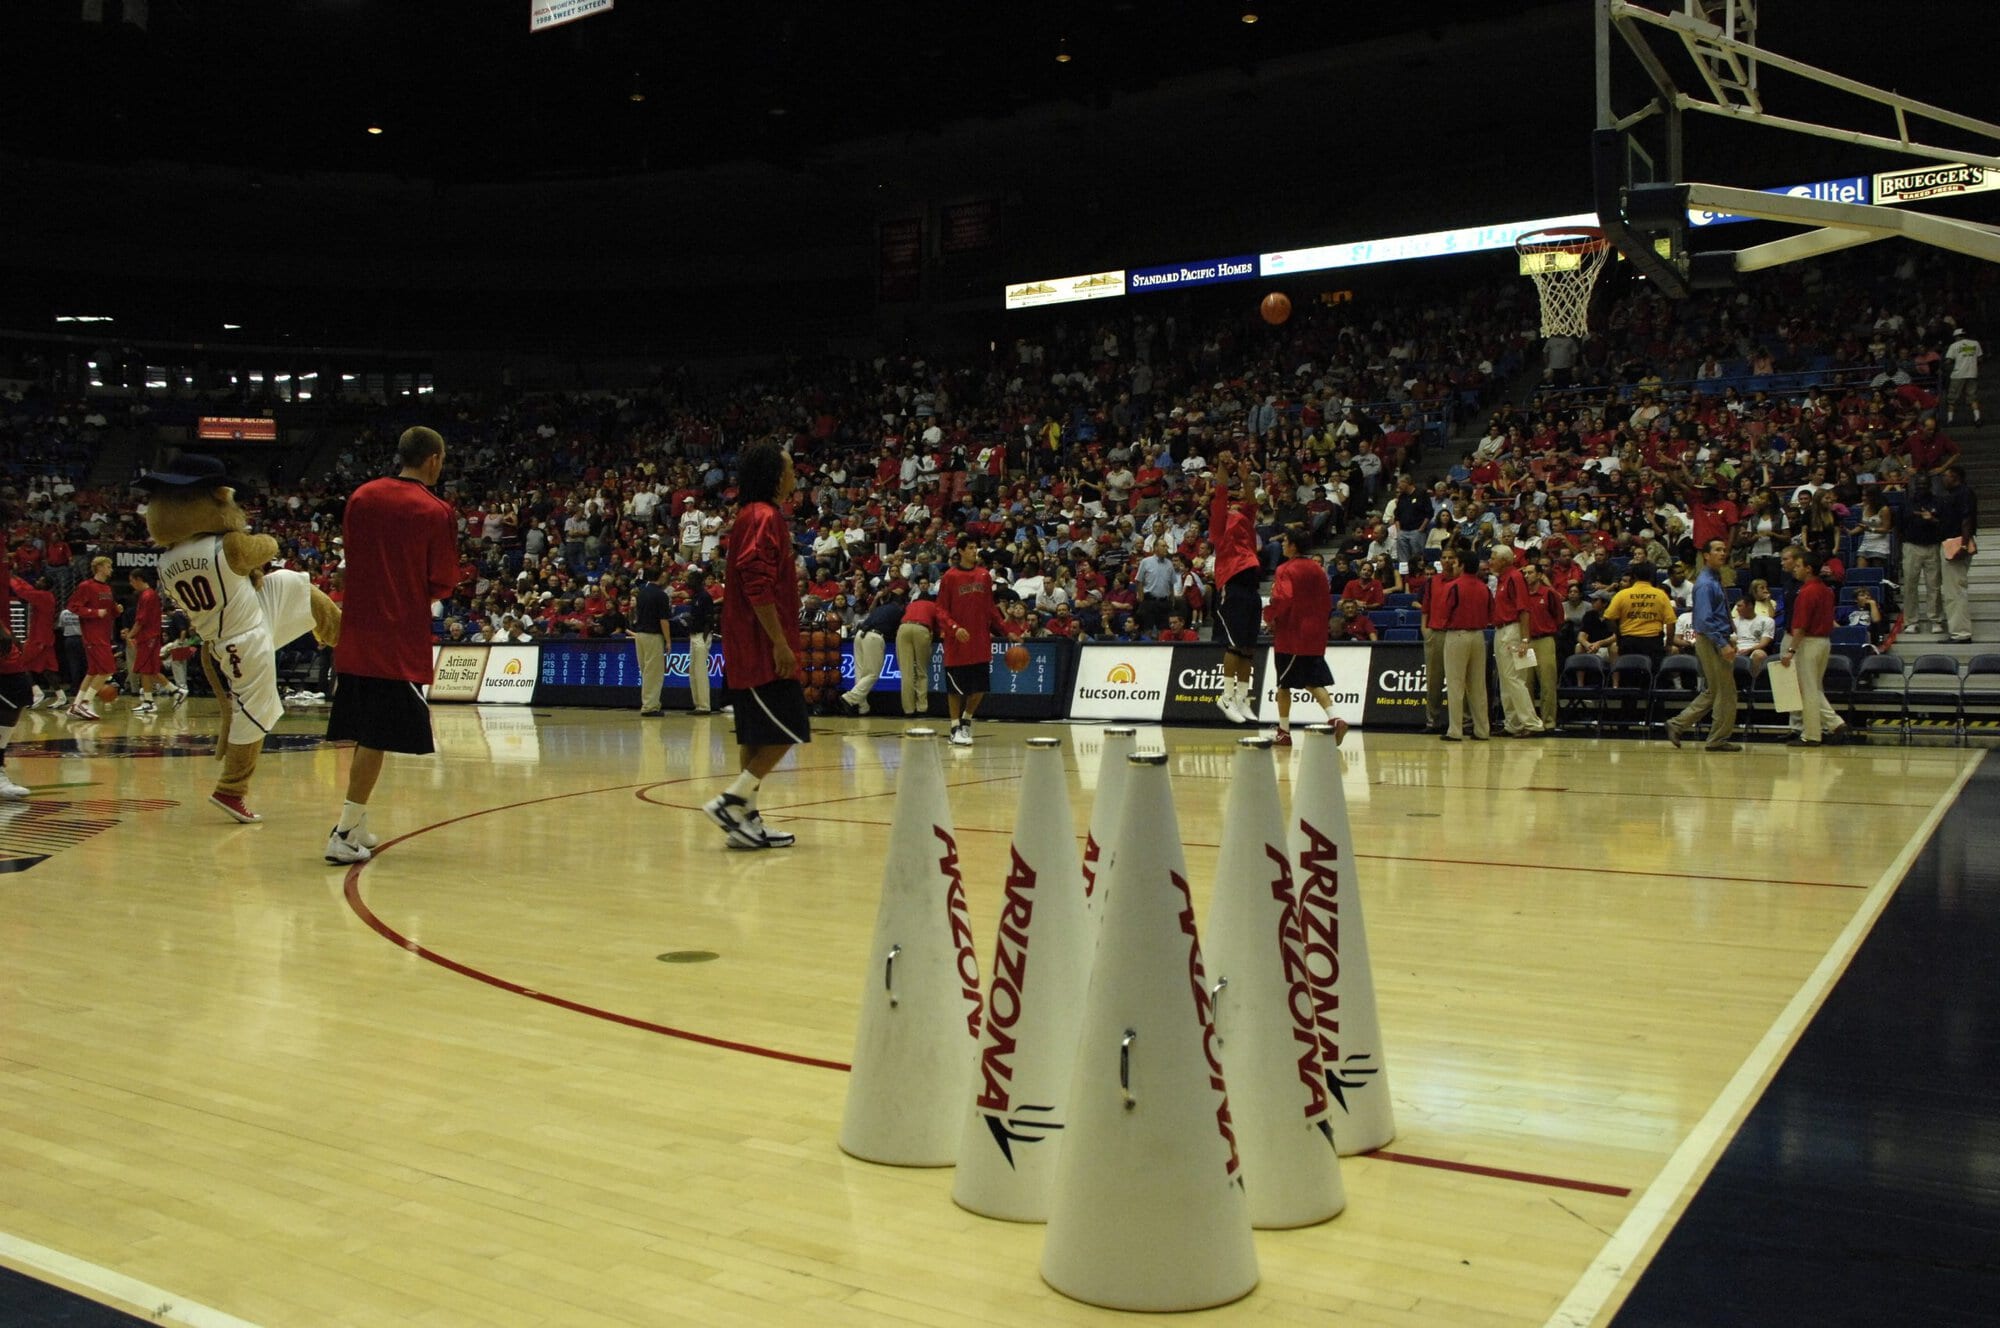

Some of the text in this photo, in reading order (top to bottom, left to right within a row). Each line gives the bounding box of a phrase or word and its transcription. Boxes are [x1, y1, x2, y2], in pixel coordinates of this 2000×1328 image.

[553, 9, 575, 19] SWEET
[577, 0, 607, 12] SIXTEEN
[1882, 167, 1983, 195] BRUEGGER'S
[1133, 263, 1253, 287] STANDARD PACIFIC HOMES
[165, 558, 209, 579] WILBUR
[175, 575, 216, 612] 00
[1627, 611, 1658, 619] SECURITY
[991, 643, 1021, 655] BLU
[225, 643, 243, 679] CATS
[446, 655, 478, 667] Arizona
[932, 655, 1046, 663] 00 44
[438, 668, 479, 682] Daily Star
[933, 665, 941, 673] 11
[1038, 665, 1044, 673] 5
[485, 677, 534, 688] tucson.com
[934, 674, 1043, 682] 0 7 4
[1378, 669, 1448, 692] Citiz
[1011, 683, 1017, 692] 2
[1039, 683, 1043, 692] 1
[1079, 686, 1160, 701] tucson.com
[1175, 694, 1192, 702] Miss
[1268, 689, 1360, 704] tsoom
[1376, 697, 1395, 705] Miss
[1403, 698, 1420, 706] day.
[932, 824, 984, 1040] ARIZON
[1300, 818, 1339, 1062] ARIZONA
[976, 839, 1037, 1112] ARIZONA
[1265, 842, 1329, 1118] ARIZONA
